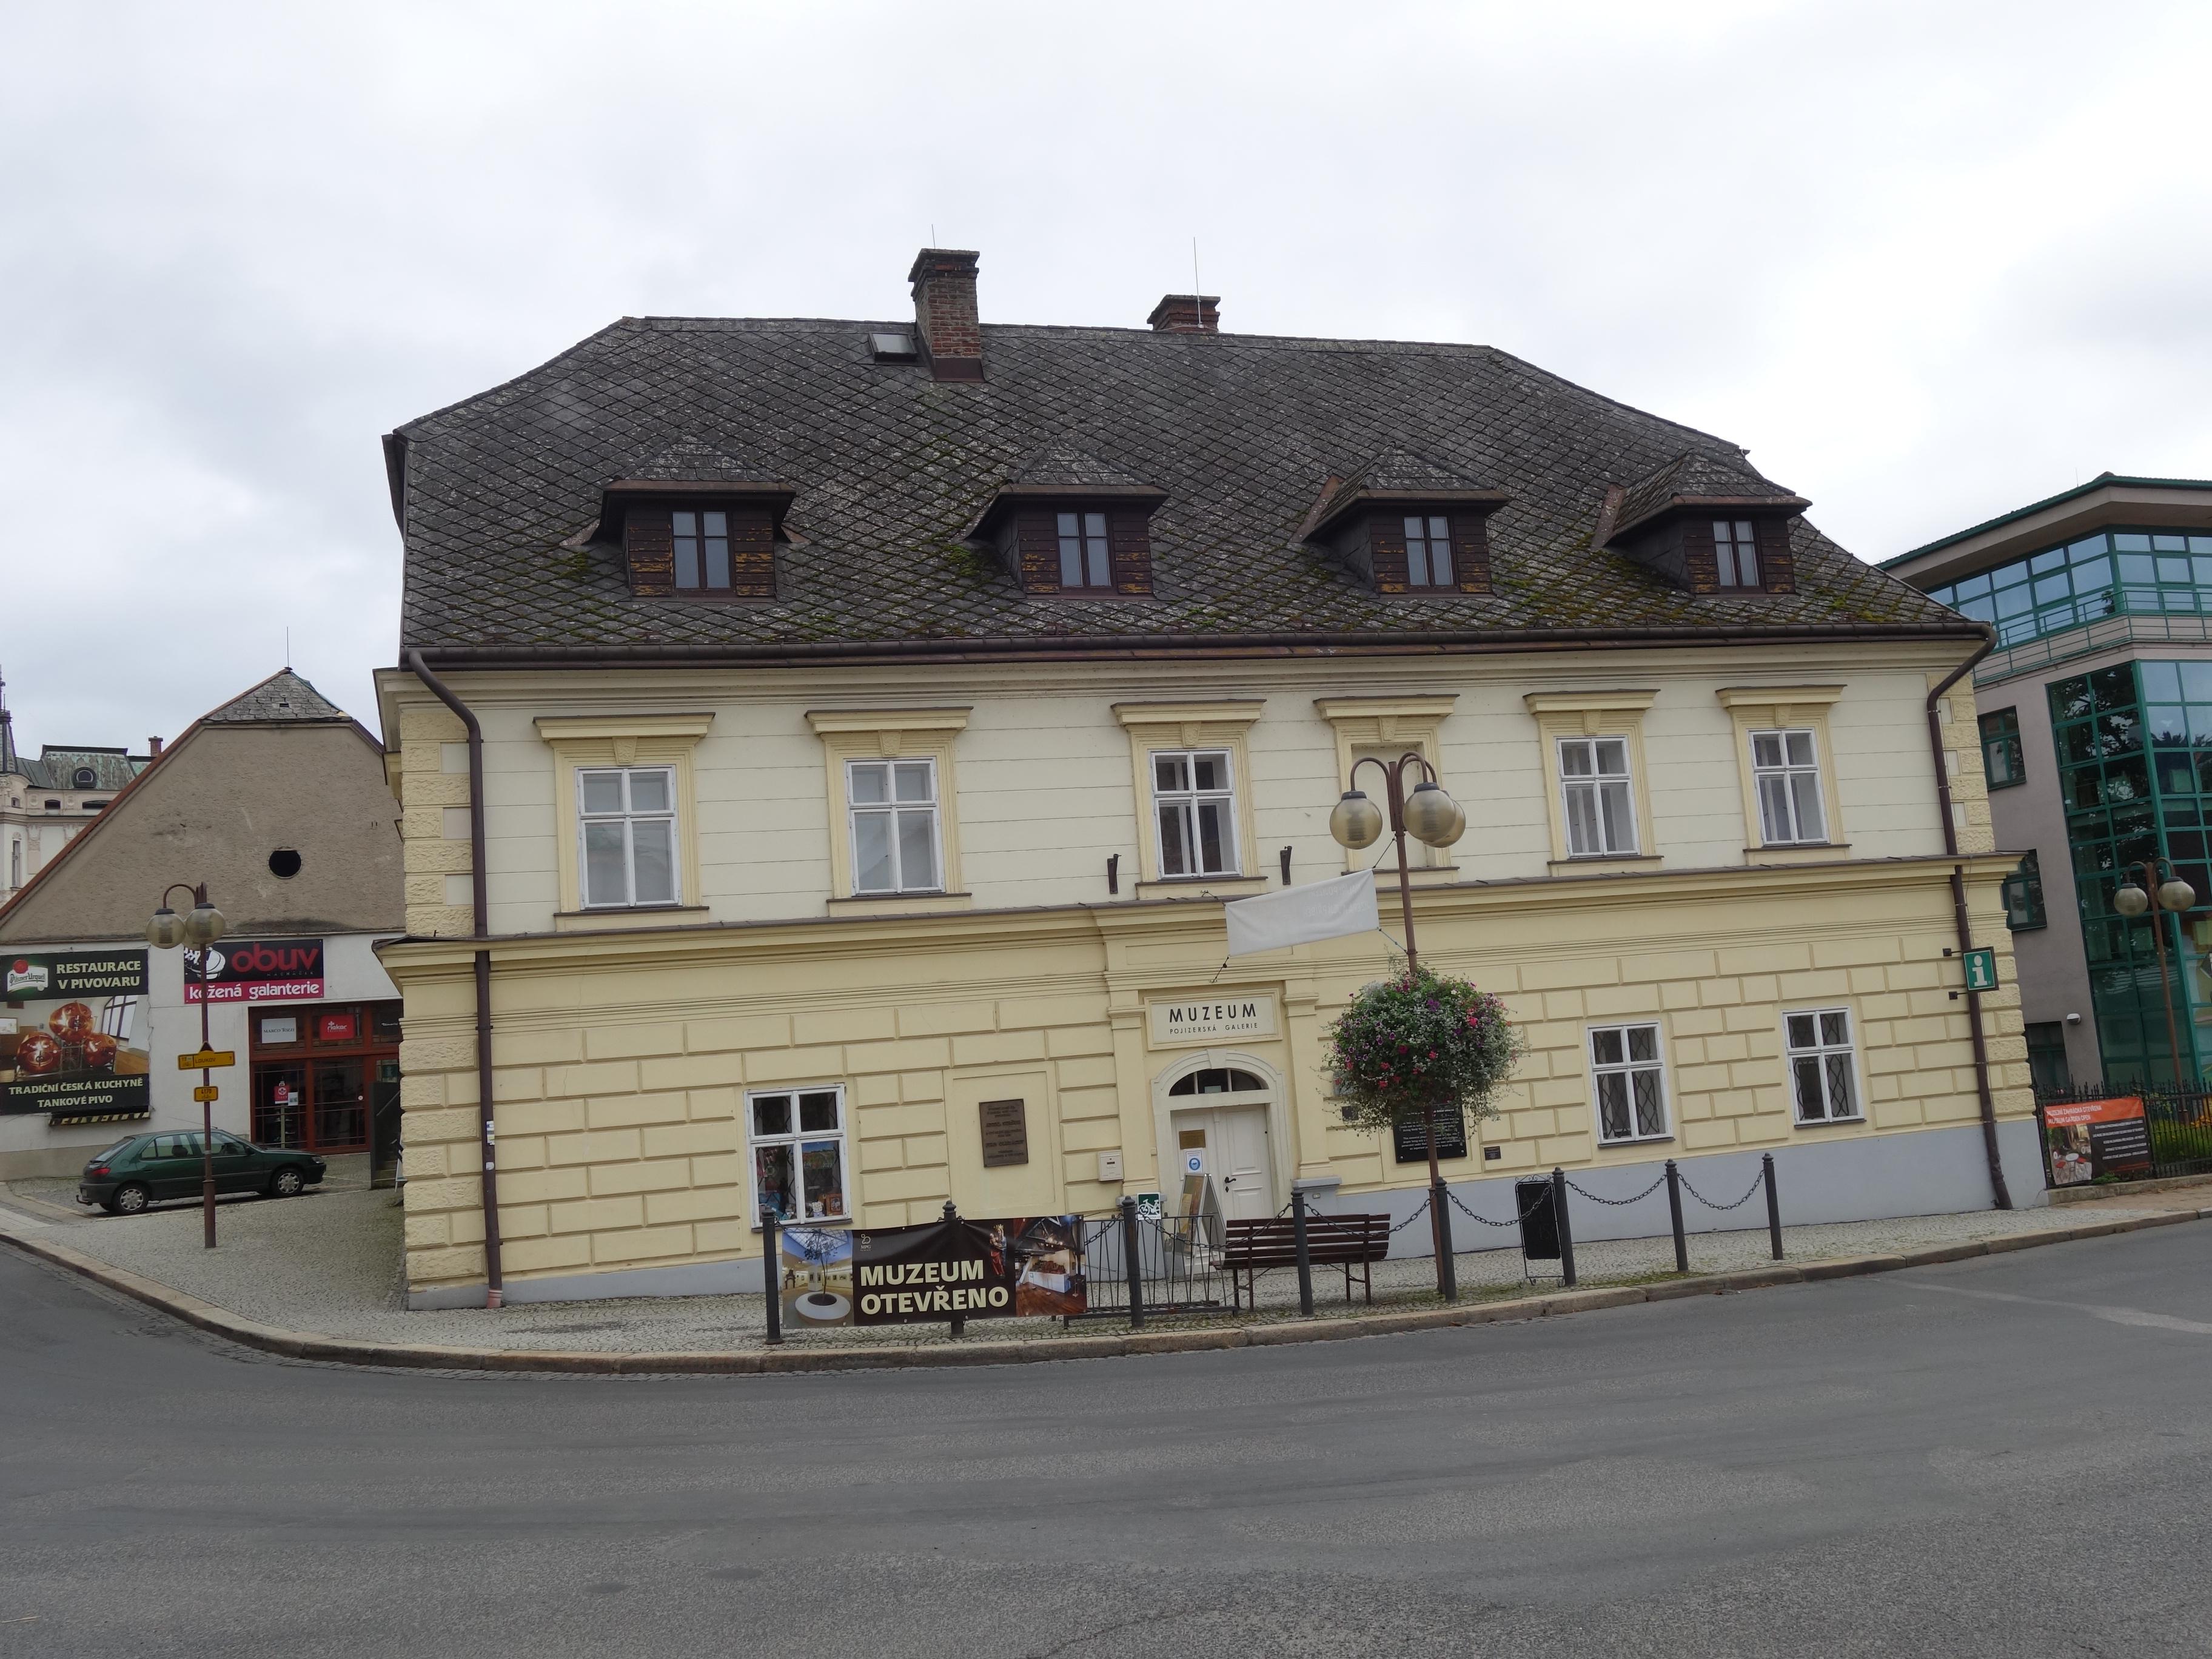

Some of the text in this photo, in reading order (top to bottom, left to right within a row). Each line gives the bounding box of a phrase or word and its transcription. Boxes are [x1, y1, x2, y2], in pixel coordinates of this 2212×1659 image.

[232, 941, 319, 973] obuv
[56, 960, 141, 974] RESTAURACE
[58, 976, 140, 990] V PIVOVARU
[249, 981, 319, 1000] galanterie
[1170, 1003, 1256, 1022] MUZEUM
[1170, 1025, 1216, 1034] POJIZERSKÁ
[8, 1078, 143, 1095] TRADIČNÍ ČESKÁ KUCHYNĚ
[37, 1095, 113, 1108] TANKOVÉ PIVO
[860, 1259, 984, 1286] MUZEUM
[860, 1285, 1009, 1315] OTEVŘENO
